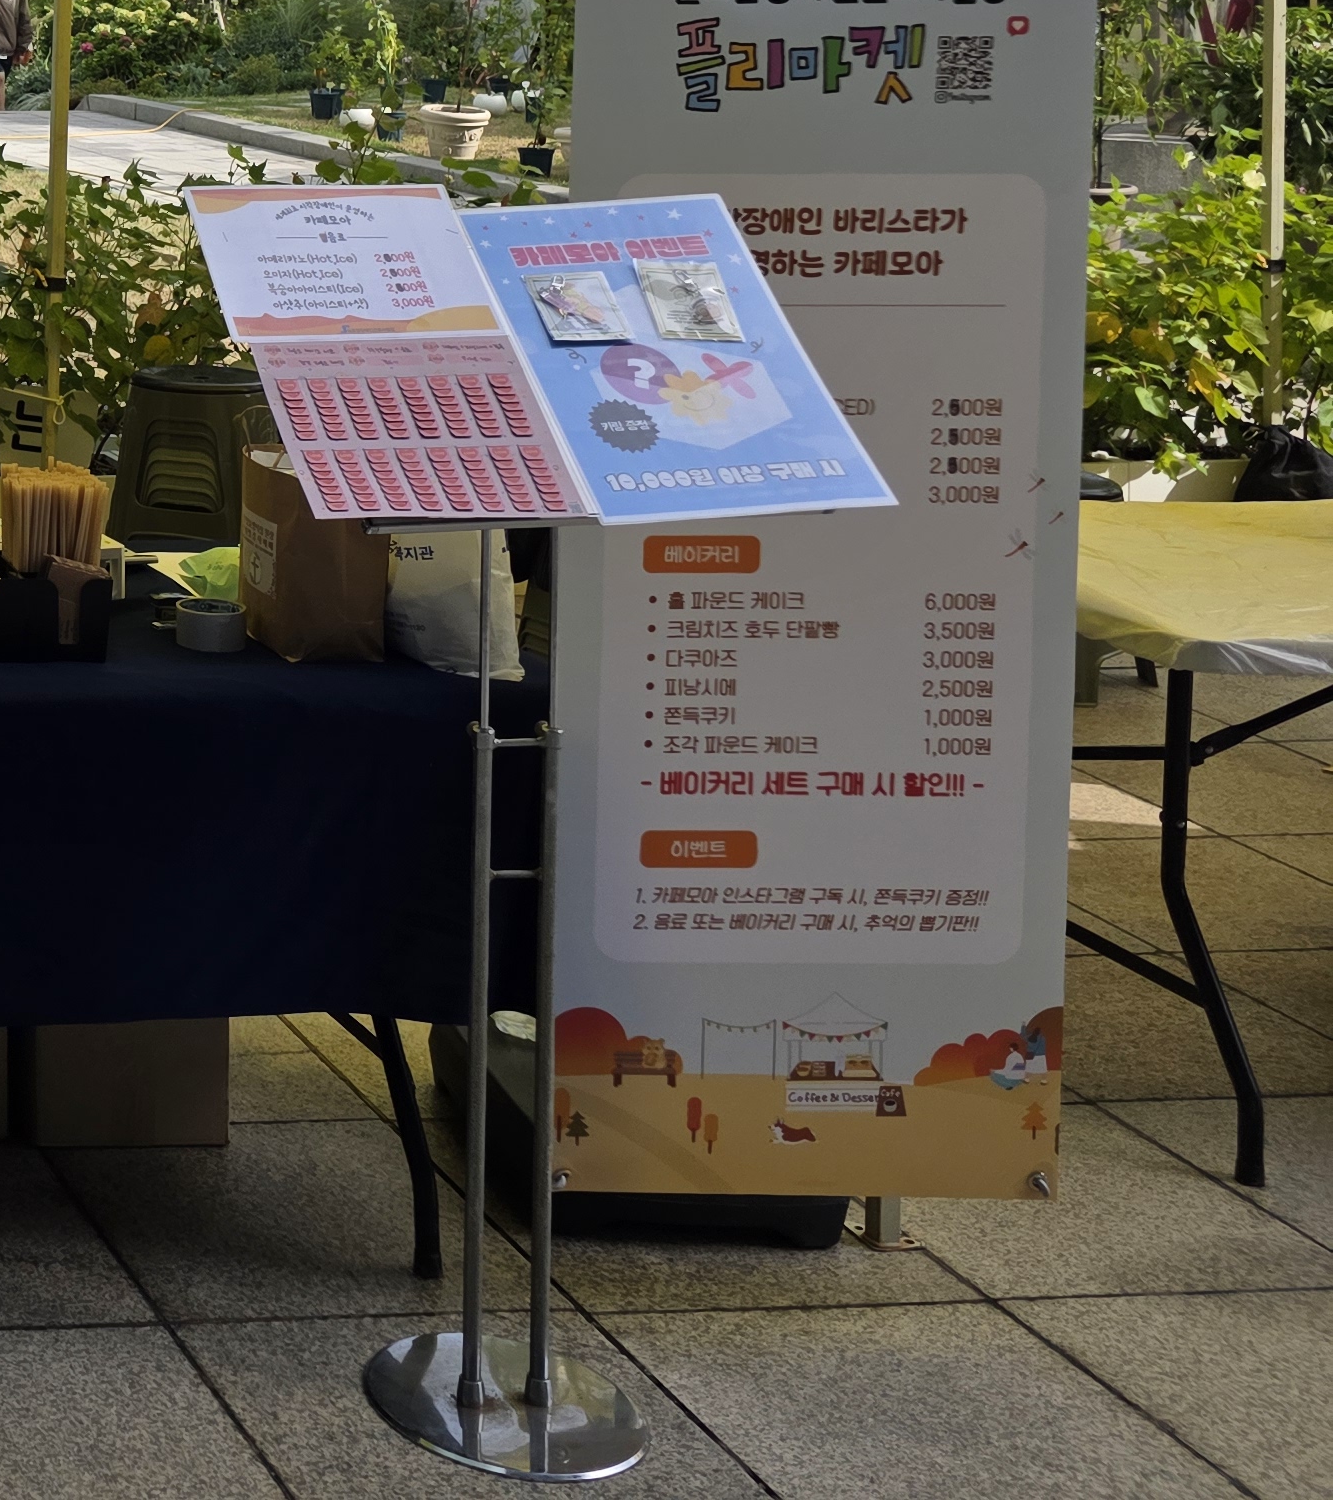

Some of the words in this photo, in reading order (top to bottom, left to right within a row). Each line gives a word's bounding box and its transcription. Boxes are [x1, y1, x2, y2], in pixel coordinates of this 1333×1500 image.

[676, 17, 927, 113] 플리마켓
[304, 215, 351, 225] 카페모아
[833, 207, 968, 236] 바리스타가
[508, 242, 621, 267] 카페모아
[625, 235, 709, 261] 이벤트
[833, 250, 944, 278] 카페모아
[392, 296, 435, 309] 3,000원
[606, 469, 715, 492] 10,000원
[723, 466, 766, 486] 이상
[770, 462, 817, 481] 구매
[823, 459, 846, 478] 시
[929, 486, 999, 505] 3,000원
[664, 545, 740, 564] 베이커리
[691, 592, 745, 609] 파운드
[751, 592, 805, 610] 케이크
[924, 593, 996, 612] 6,000원
[666, 620, 738, 639] 크림치즈
[745, 620, 779, 639] 호두
[786, 620, 840, 640] 단팥빵
[923, 622, 995, 641] 3,500원
[665, 650, 738, 668] 다쿠아즈
[923, 651, 994, 671] 3,000원
[665, 678, 736, 698] 피낭시에
[922, 679, 993, 699] 2,500원
[663, 707, 735, 726] 쫀득쿠키
[924, 709, 992, 728] 1,000원
[662, 736, 699, 755] 조각
[704, 736, 758, 754] 파운드
[764, 736, 819, 755] 케이크
[923, 738, 991, 757] 1,000원
[660, 771, 754, 796] 베이커리
[761, 771, 809, 796] 세트
[815, 772, 864, 797] 구매
[871, 772, 895, 797] 시
[670, 840, 727, 859] 이벤트
[653, 888, 718, 905] 카페모아
[722, 888, 805, 905] 인스타그램
[810, 888, 842, 905] 구독
[654, 914, 688, 930] 음료
[691, 914, 725, 930] 또는
[729, 914, 794, 931] 베이커리
[800, 914, 833, 931] 구매
[788, 1092, 828, 1102] Coffee
[830, 1093, 839, 1102] &
[881, 1089, 901, 1097] Cafe
